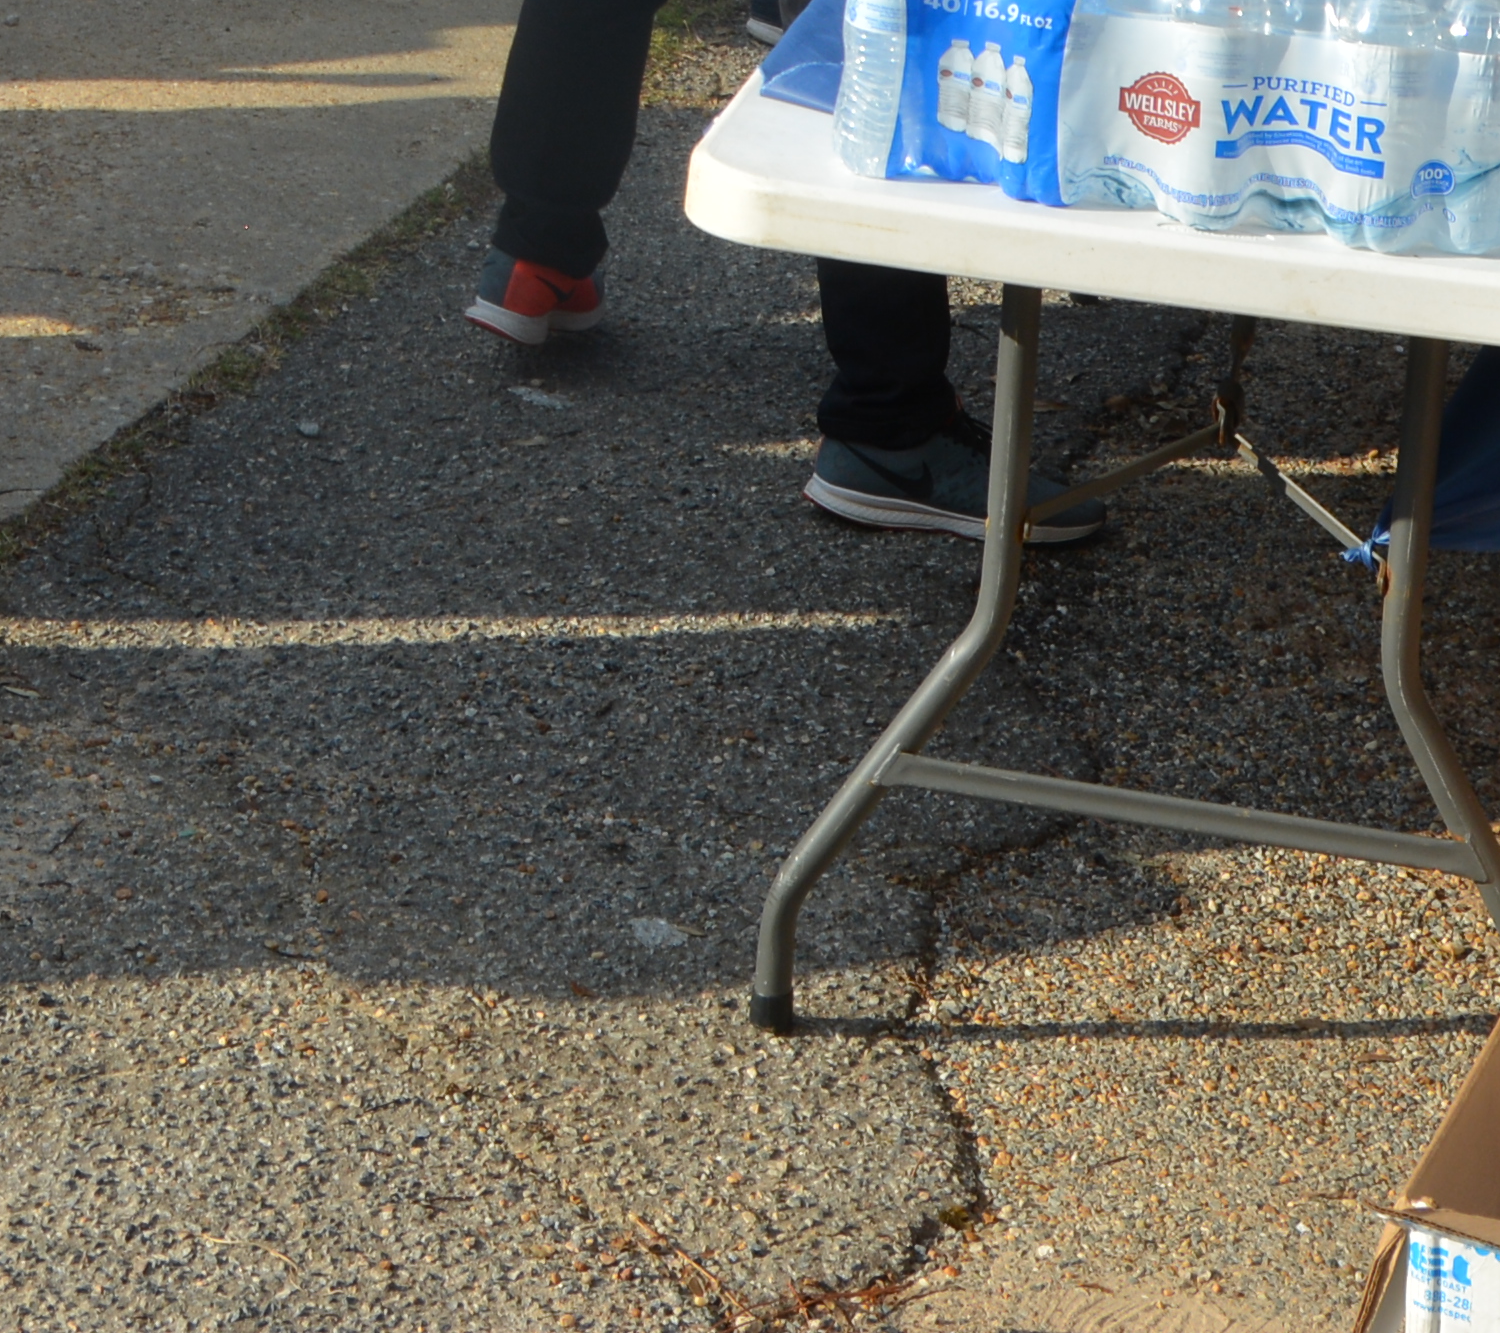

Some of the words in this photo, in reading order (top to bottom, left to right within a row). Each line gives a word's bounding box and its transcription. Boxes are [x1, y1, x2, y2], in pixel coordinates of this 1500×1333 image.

[973, 0, 1019, 22] 16.9
[1020, 14, 1032, 27] FL
[1034, 17, 1053, 29] OZ
[1124, 91, 1196, 123] WELLSLEY
[1253, 76, 1355, 107] PURIFIED
[1221, 95, 1386, 154] WATER
[1437, 1276, 1467, 1294] COAST
